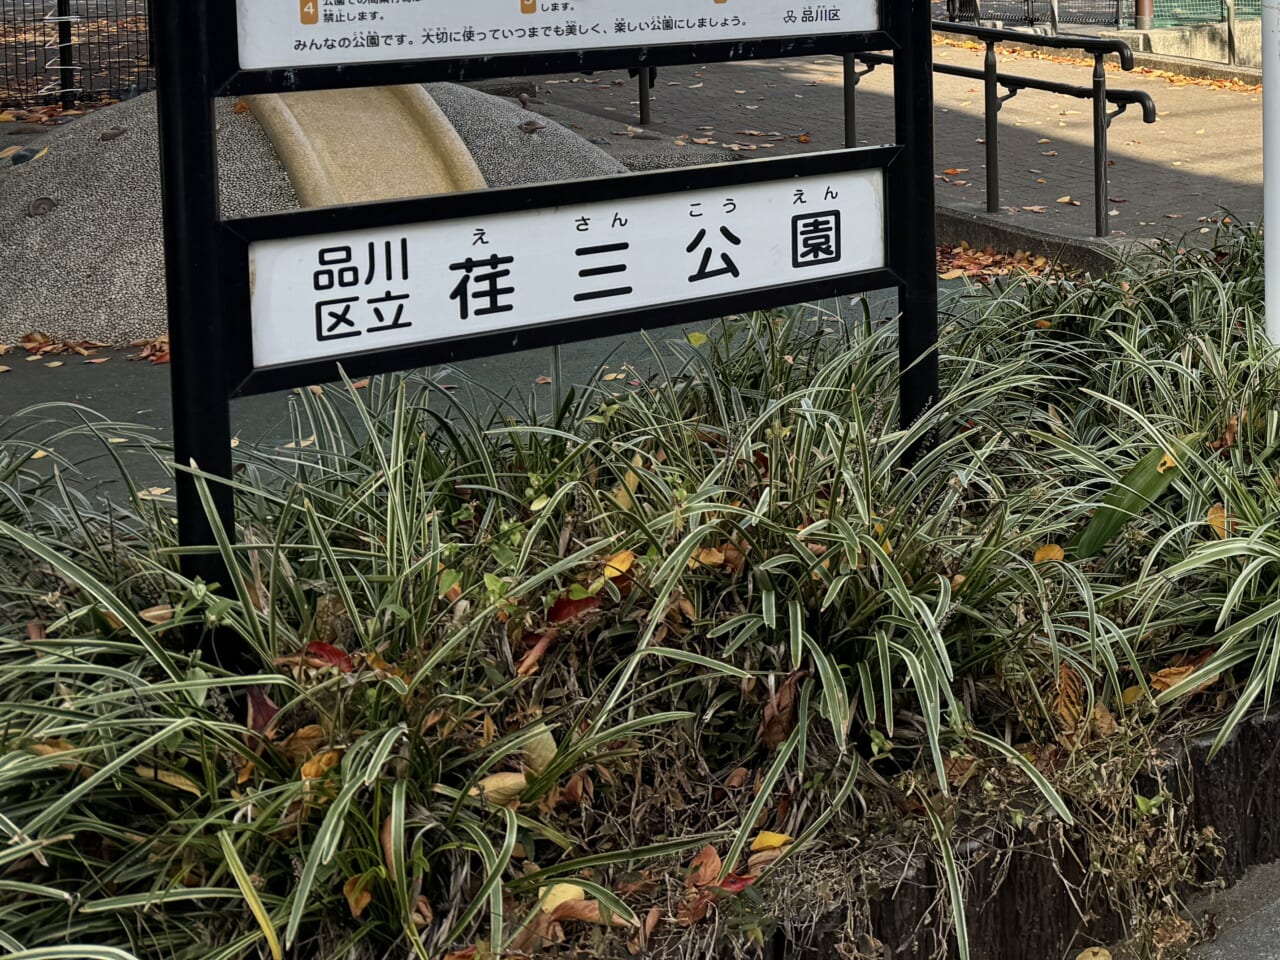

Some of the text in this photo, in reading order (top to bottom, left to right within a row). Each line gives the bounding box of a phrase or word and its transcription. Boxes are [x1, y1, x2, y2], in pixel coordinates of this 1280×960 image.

[303, 2, 315, 15] 4
[541, 2, 574, 12] します。
[801, 8, 841, 22] 品川区
[472, 228, 490, 246] え
